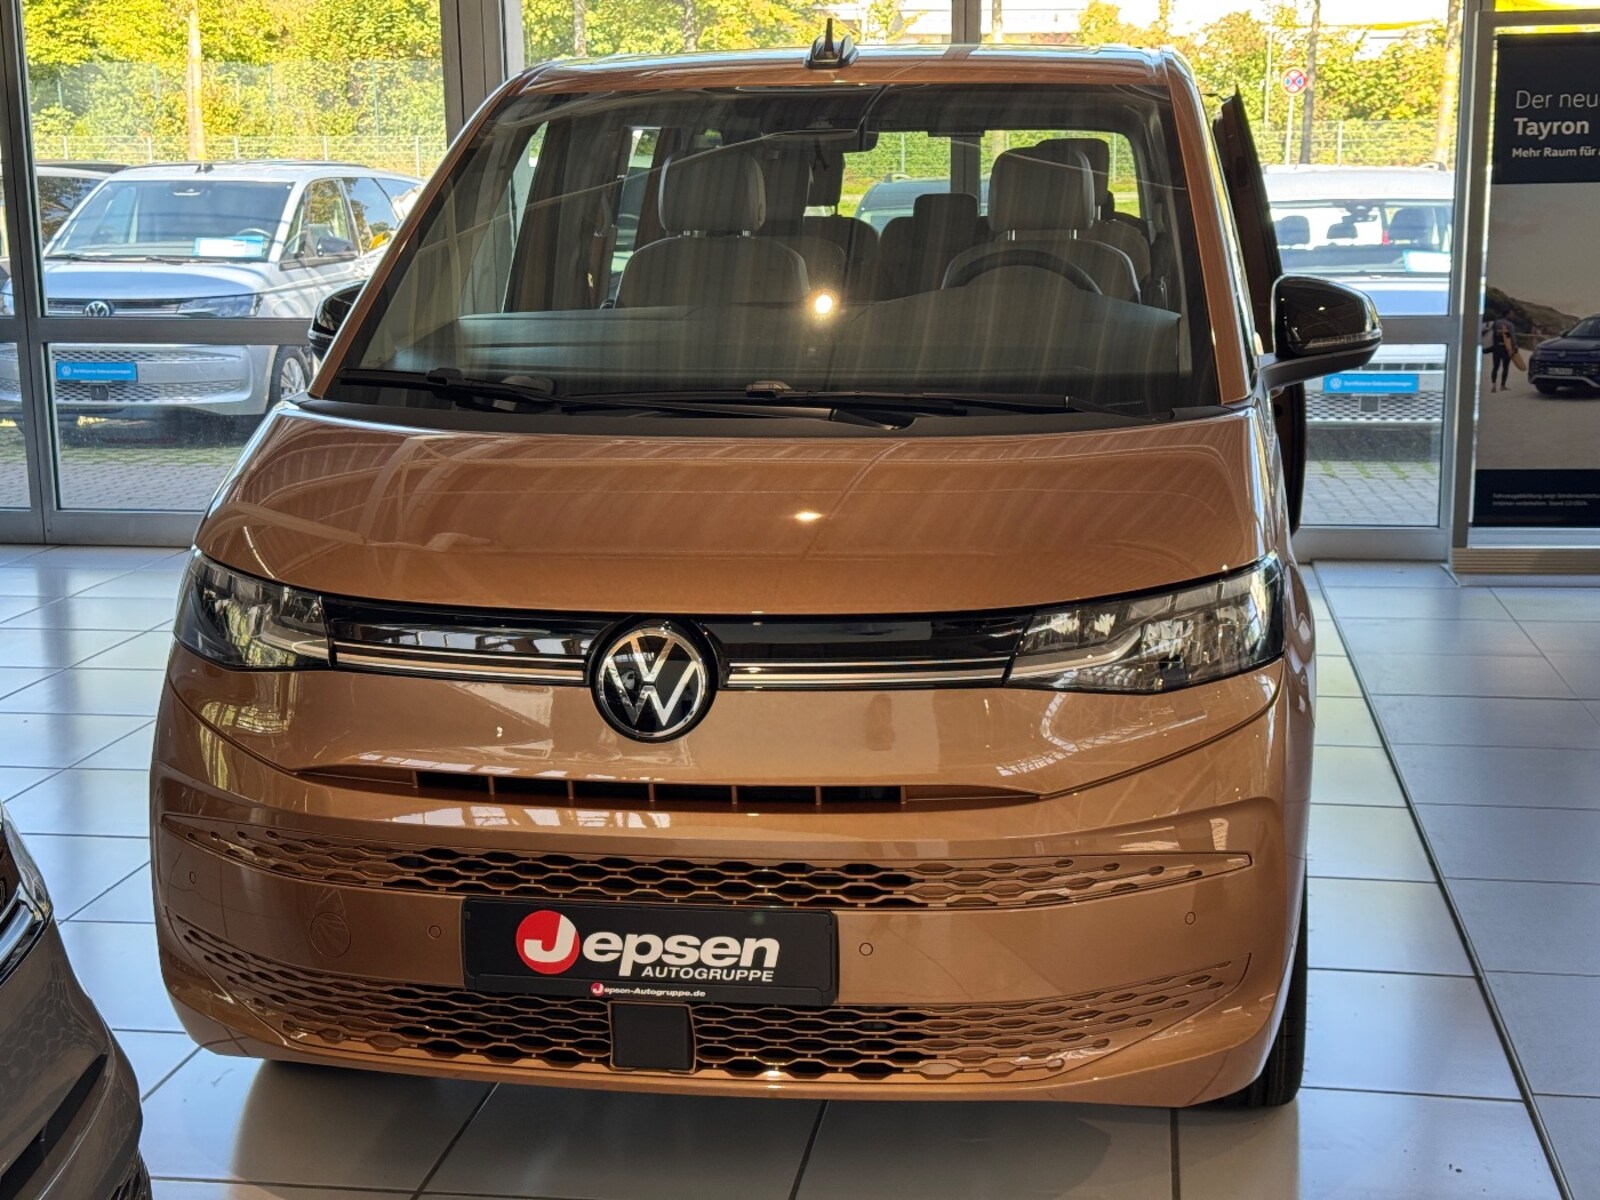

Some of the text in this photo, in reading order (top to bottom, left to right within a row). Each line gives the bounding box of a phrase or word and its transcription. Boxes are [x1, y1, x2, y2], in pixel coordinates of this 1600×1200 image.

[1515, 90, 1600, 109] Der neu
[1513, 117, 1589, 140] Tayron
[1512, 147, 1541, 158] Mehr
[1543, 147, 1577, 157] Raum
[1580, 146, 1596, 156] für
[522, 912, 780, 977] Jepsen
[641, 965, 774, 982] AUTOGRUPPE
[592, 983, 706, 997] Jepsen-Autogruppe.de
